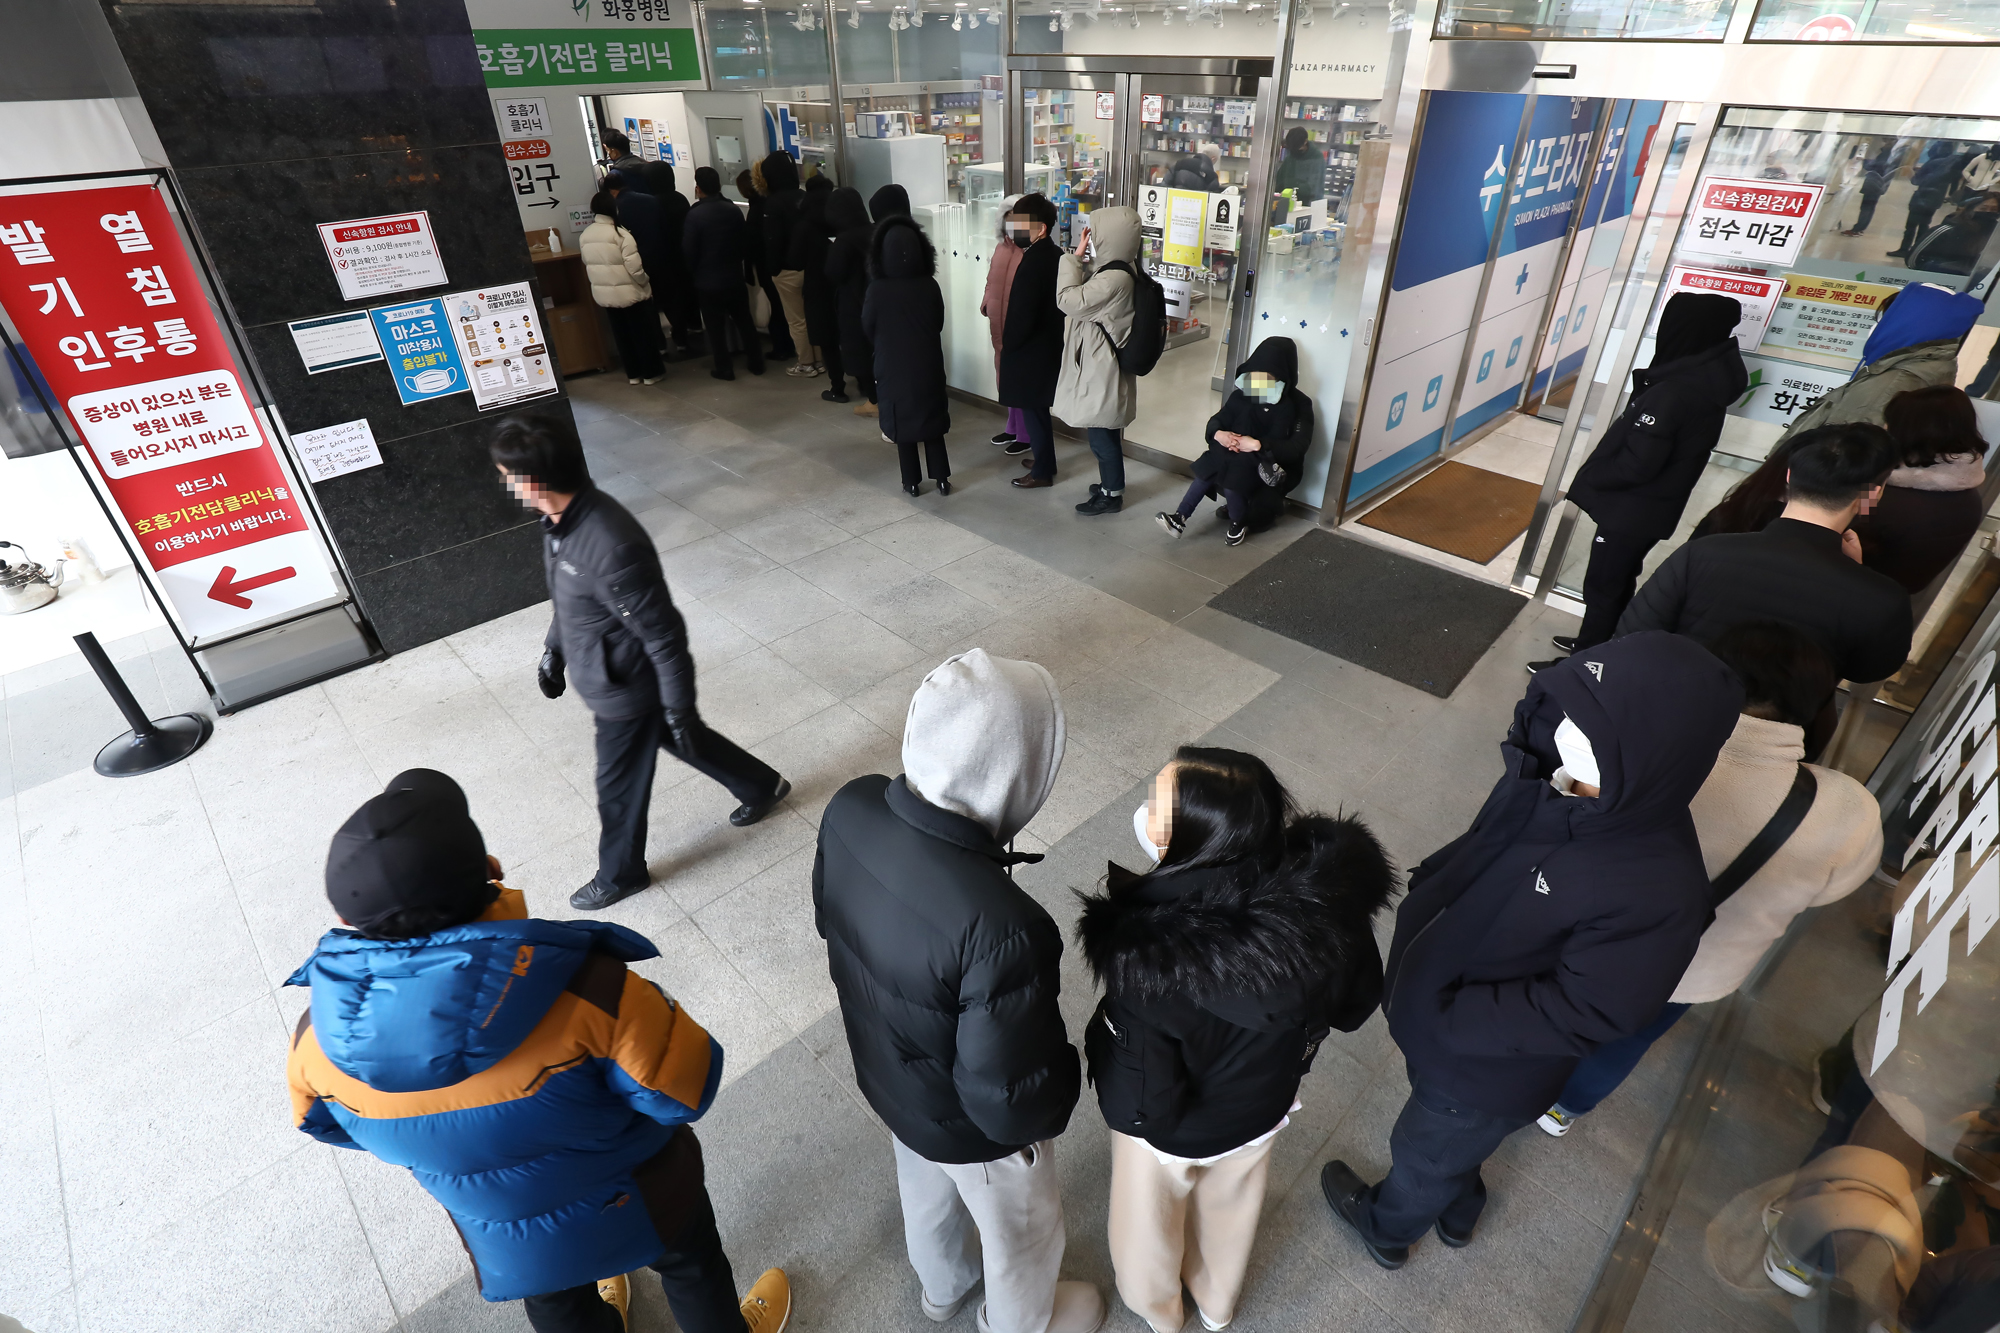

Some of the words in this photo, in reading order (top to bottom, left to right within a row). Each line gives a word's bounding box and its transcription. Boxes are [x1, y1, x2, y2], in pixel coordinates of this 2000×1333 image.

[602, 0, 670, 21] 화홍병원
[477, 41, 597, 76] 호흡기전담
[605, 41, 673, 72] 클리닉
[1321, 64, 1375, 73] PHARMACY
[507, 103, 539, 117] 호흡기
[511, 118, 543, 132] 클리닉
[505, 142, 547, 157] 접수,수납
[512, 163, 560, 195] 입구
[1710, 190, 1804, 214] 신속항원검사
[1299, 219, 1308, 229] 17
[1514, 210, 1534, 226] SUWON
[1534, 206, 1550, 220] PLAZA
[0, 220, 55, 266] 발
[100, 210, 154, 254] 열
[342, 226, 376, 240] 신속항원
[377, 224, 394, 235] 검사
[395, 222, 413, 232] 안내
[1699, 216, 1741, 241] 접수
[1746, 222, 1794, 247] 마감
[345, 246, 360, 255] 비용
[350, 256, 378, 267] 결과확인
[384, 254, 396, 262] 검사
[28, 277, 85, 318] 기
[126, 265, 177, 307] 침
[1689, 276, 1722, 288] 신속항원
[1723, 281, 1742, 291] 검사
[1743, 284, 1762, 294] 안내
[486, 292, 511, 303] 코로나19
[487, 300, 504, 309] 이렇게
[505, 296, 527, 307] 해주세요!
[1795, 285, 1827, 299] 출입문
[1829, 289, 1852, 302] 개방
[1853, 293, 1877, 306] 안내
[1749, 314, 1763, 322] 소요
[390, 319, 438, 341] 마스크
[58, 317, 198, 373] 인후통
[397, 336, 443, 356] 미착용시
[402, 351, 448, 371] 출입불가
[1781, 378, 1823, 394] 의료법인
[83, 399, 140, 423] 증상이
[141, 388, 196, 412] 있으신
[198, 381, 232, 401] 분은
[132, 417, 171, 437] 병원
[172, 410, 208, 429] 내로
[332, 426, 355, 437] 입니다
[110, 435, 198, 467] 들어오시지
[198, 425, 250, 447] 마시고
[175, 473, 228, 497] 반드시
[134, 486, 290, 536] 호흡기전담클리닉을
[154, 523, 230, 552] 이용하시기
[229, 508, 292, 530] 바랍니다.
[1870, 650, 2000, 1078] OFFEE
